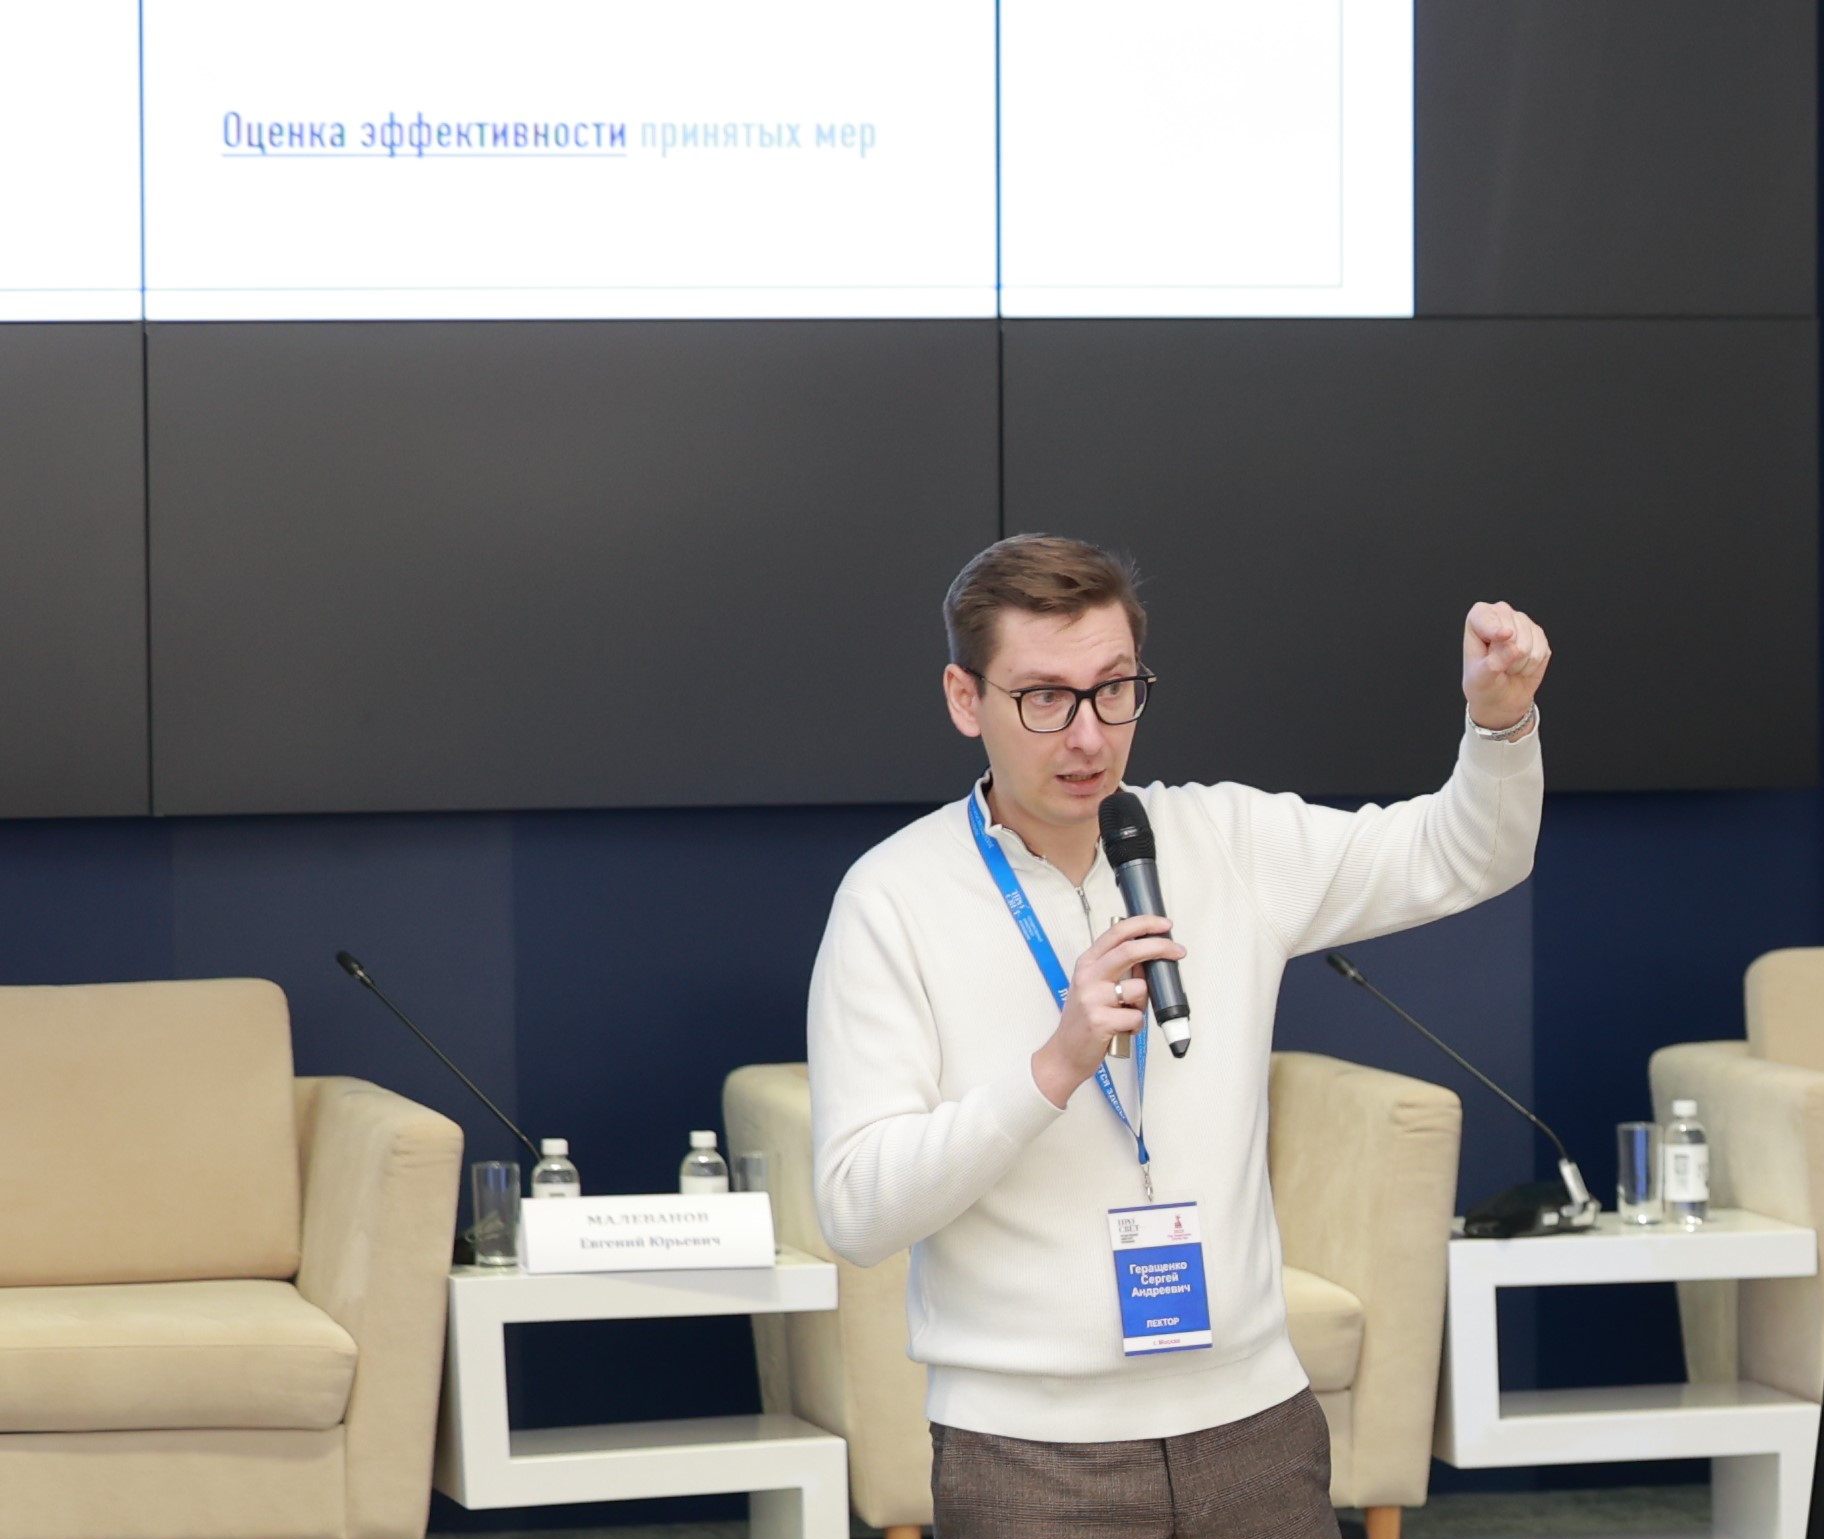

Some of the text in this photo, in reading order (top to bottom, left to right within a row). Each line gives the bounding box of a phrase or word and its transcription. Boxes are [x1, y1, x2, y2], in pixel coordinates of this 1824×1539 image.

[222, 111, 877, 158] Оценка эффективности принятых мер
[580, 1235, 721, 1251] Евгений Юрьевич
[1129, 1261, 1188, 1275] Геращенко
[1141, 1272, 1180, 1286] Сергей
[1131, 1284, 1191, 1298] Андреевич
[1146, 1317, 1180, 1329] ЛЕКТОР
